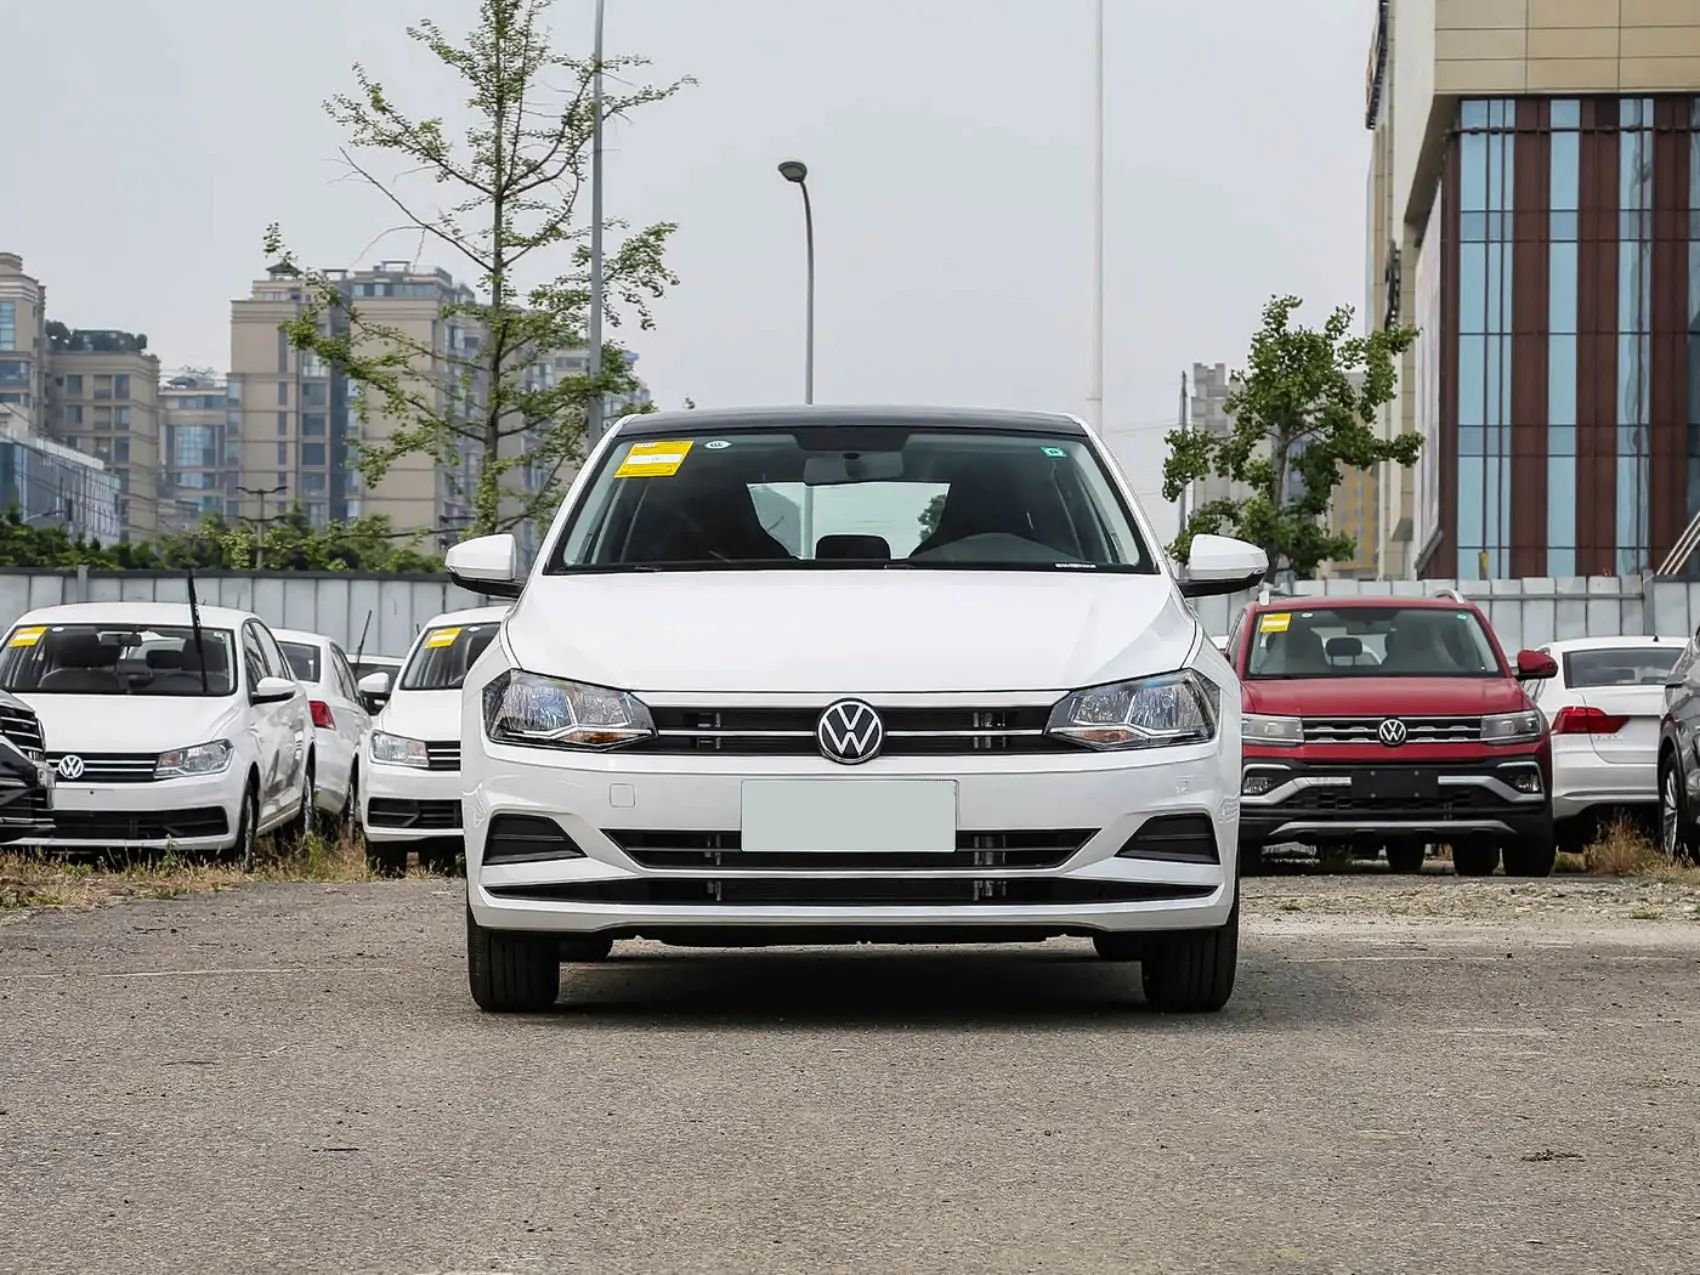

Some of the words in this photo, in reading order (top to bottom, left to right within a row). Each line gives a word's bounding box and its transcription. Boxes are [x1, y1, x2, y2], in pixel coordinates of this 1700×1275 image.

[820, 702, 881, 758] VW
[1380, 720, 1405, 743] VW
[60, 755, 83, 778] VW
